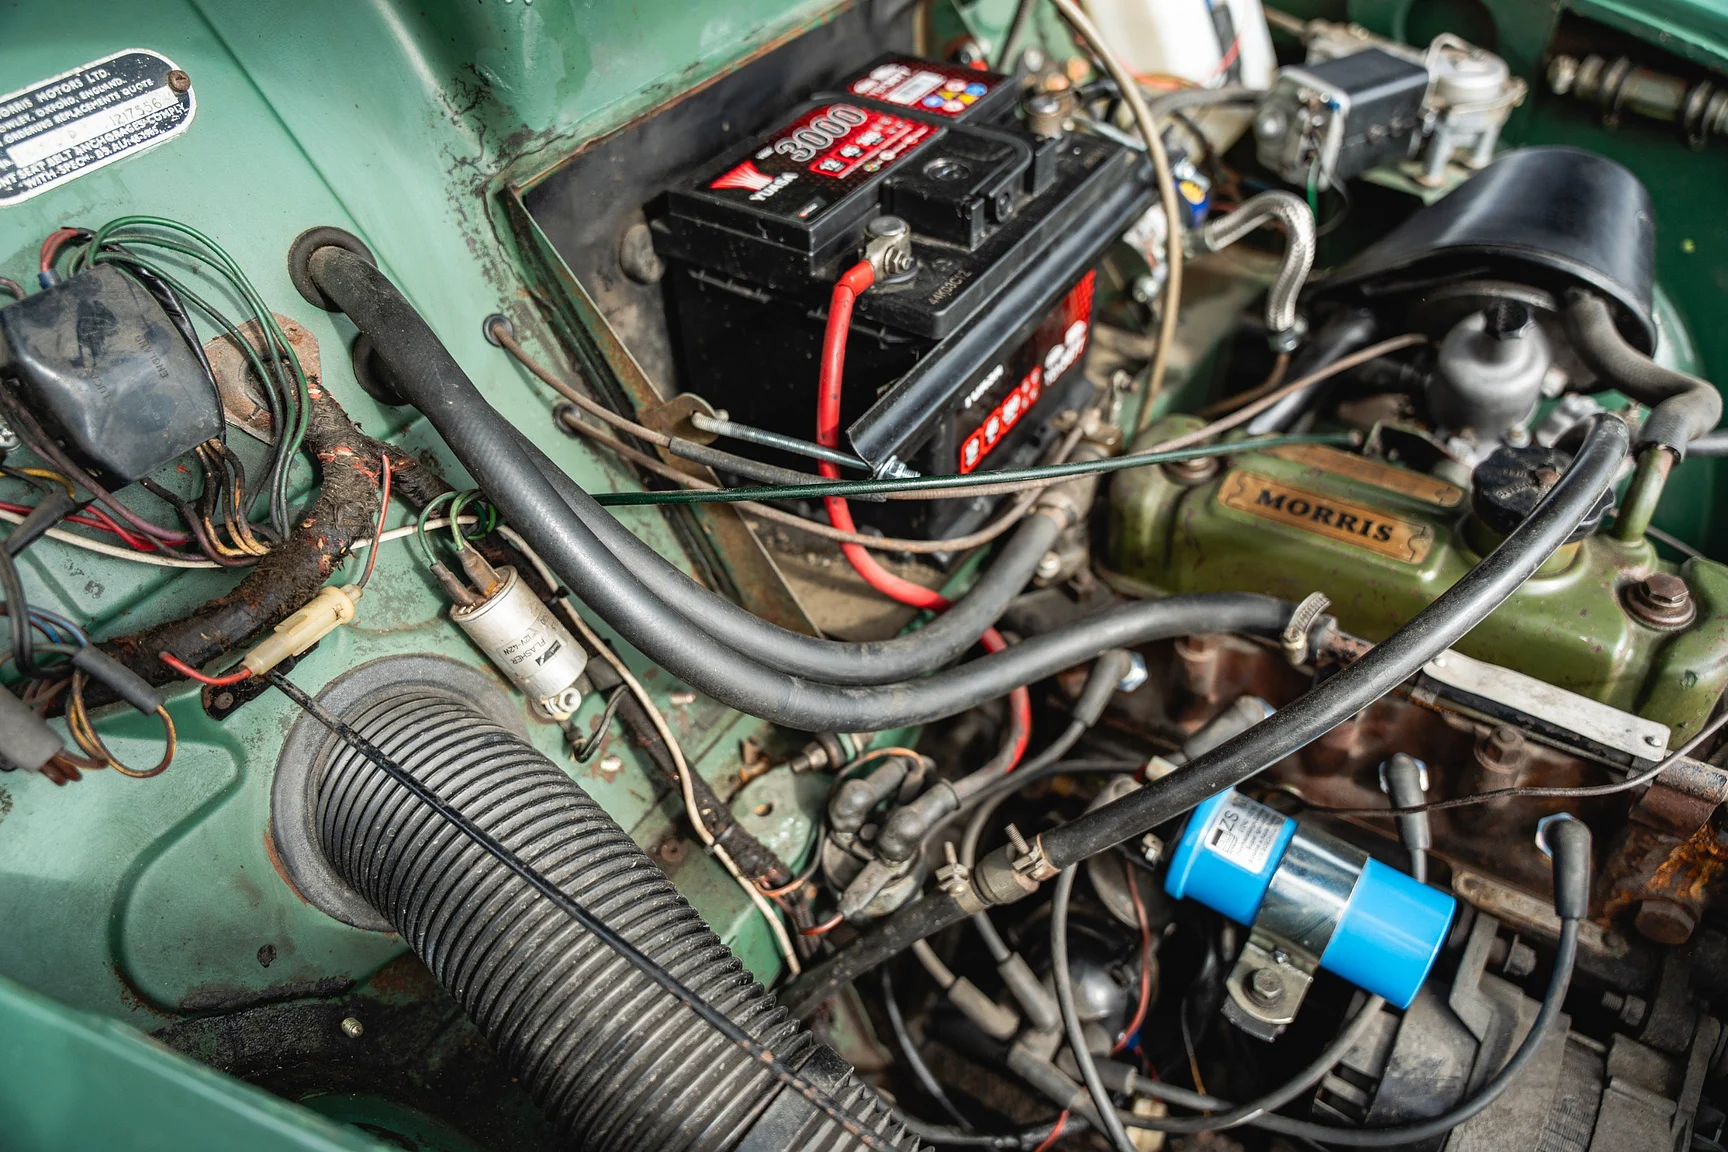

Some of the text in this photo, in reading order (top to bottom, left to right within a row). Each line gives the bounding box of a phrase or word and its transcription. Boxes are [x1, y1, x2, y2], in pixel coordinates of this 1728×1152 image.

[0, 69, 111, 119] ORRIS MOTORS LTD.
[3, 78, 154, 144] ORDERING REPLACEMENTS QUOTE
[109, 97, 162, 126] 1217556
[16, 160, 47, 180] SEAT
[46, 149, 73, 169] BELT
[74, 119, 146, 156] ANCHORAGES
[146, 102, 184, 125] COMPLY
[774, 103, 868, 162] 3000
[749, 172, 799, 201] YUASA
[135, 334, 169, 379] ENGLAND
[1255, 489, 1393, 543] MORRIS
[510, 637, 546, 665] FLASHER
[1218, 810, 1239, 832] ZS
